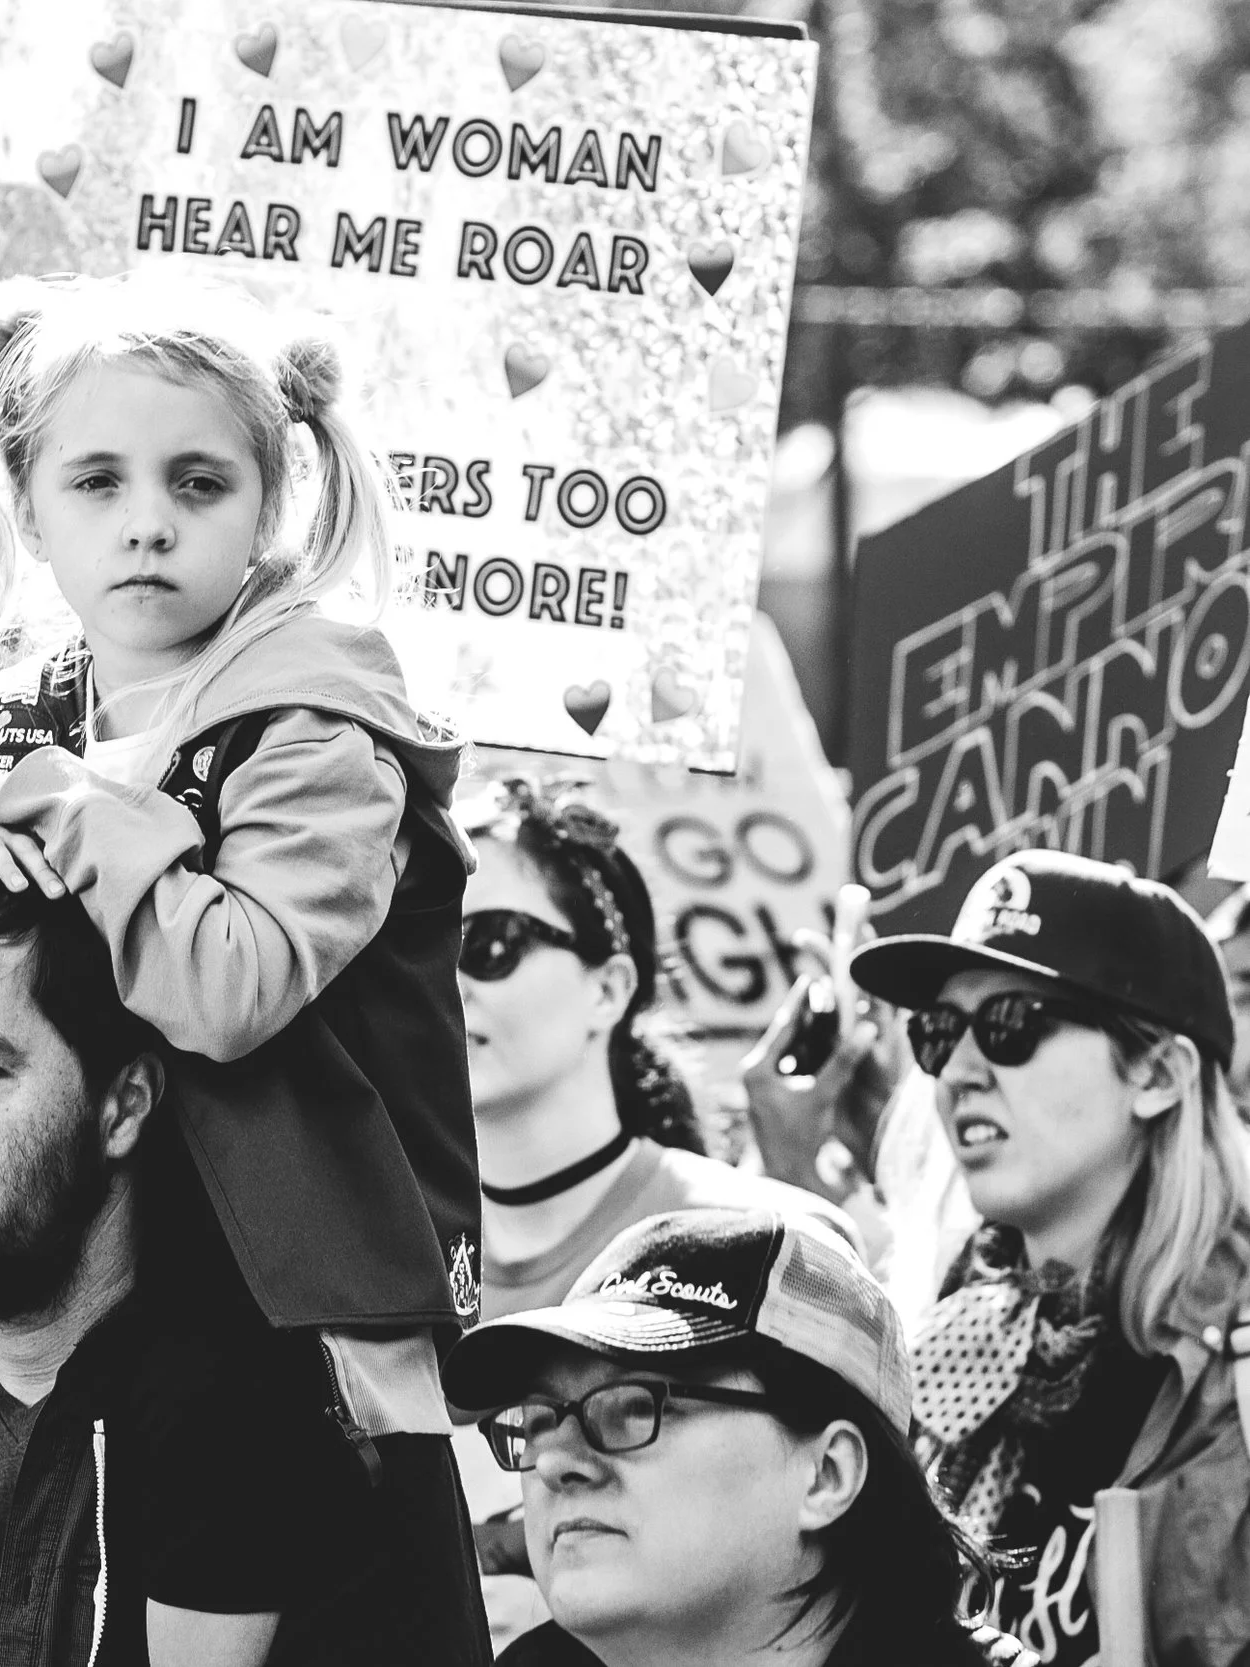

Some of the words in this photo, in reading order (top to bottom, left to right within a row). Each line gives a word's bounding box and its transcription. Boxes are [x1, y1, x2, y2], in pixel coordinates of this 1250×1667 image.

[177, 97, 197, 154] I
[240, 104, 344, 168] AM
[387, 112, 662, 192] WOMAN
[136, 194, 302, 262] HEAR
[330, 212, 423, 277] ME
[457, 221, 649, 295] ROAR
[388, 453, 493, 519] ERS
[522, 463, 668, 535] TOO
[1013, 336, 1213, 572] THE
[422, 550, 629, 630] NORE!
[885, 436, 1250, 772] EMPIR
[26, 728, 54, 745] USA
[654, 812, 816, 891] GO
[600, 1270, 651, 1297] Girl
[651, 1270, 738, 1310] Scouts
